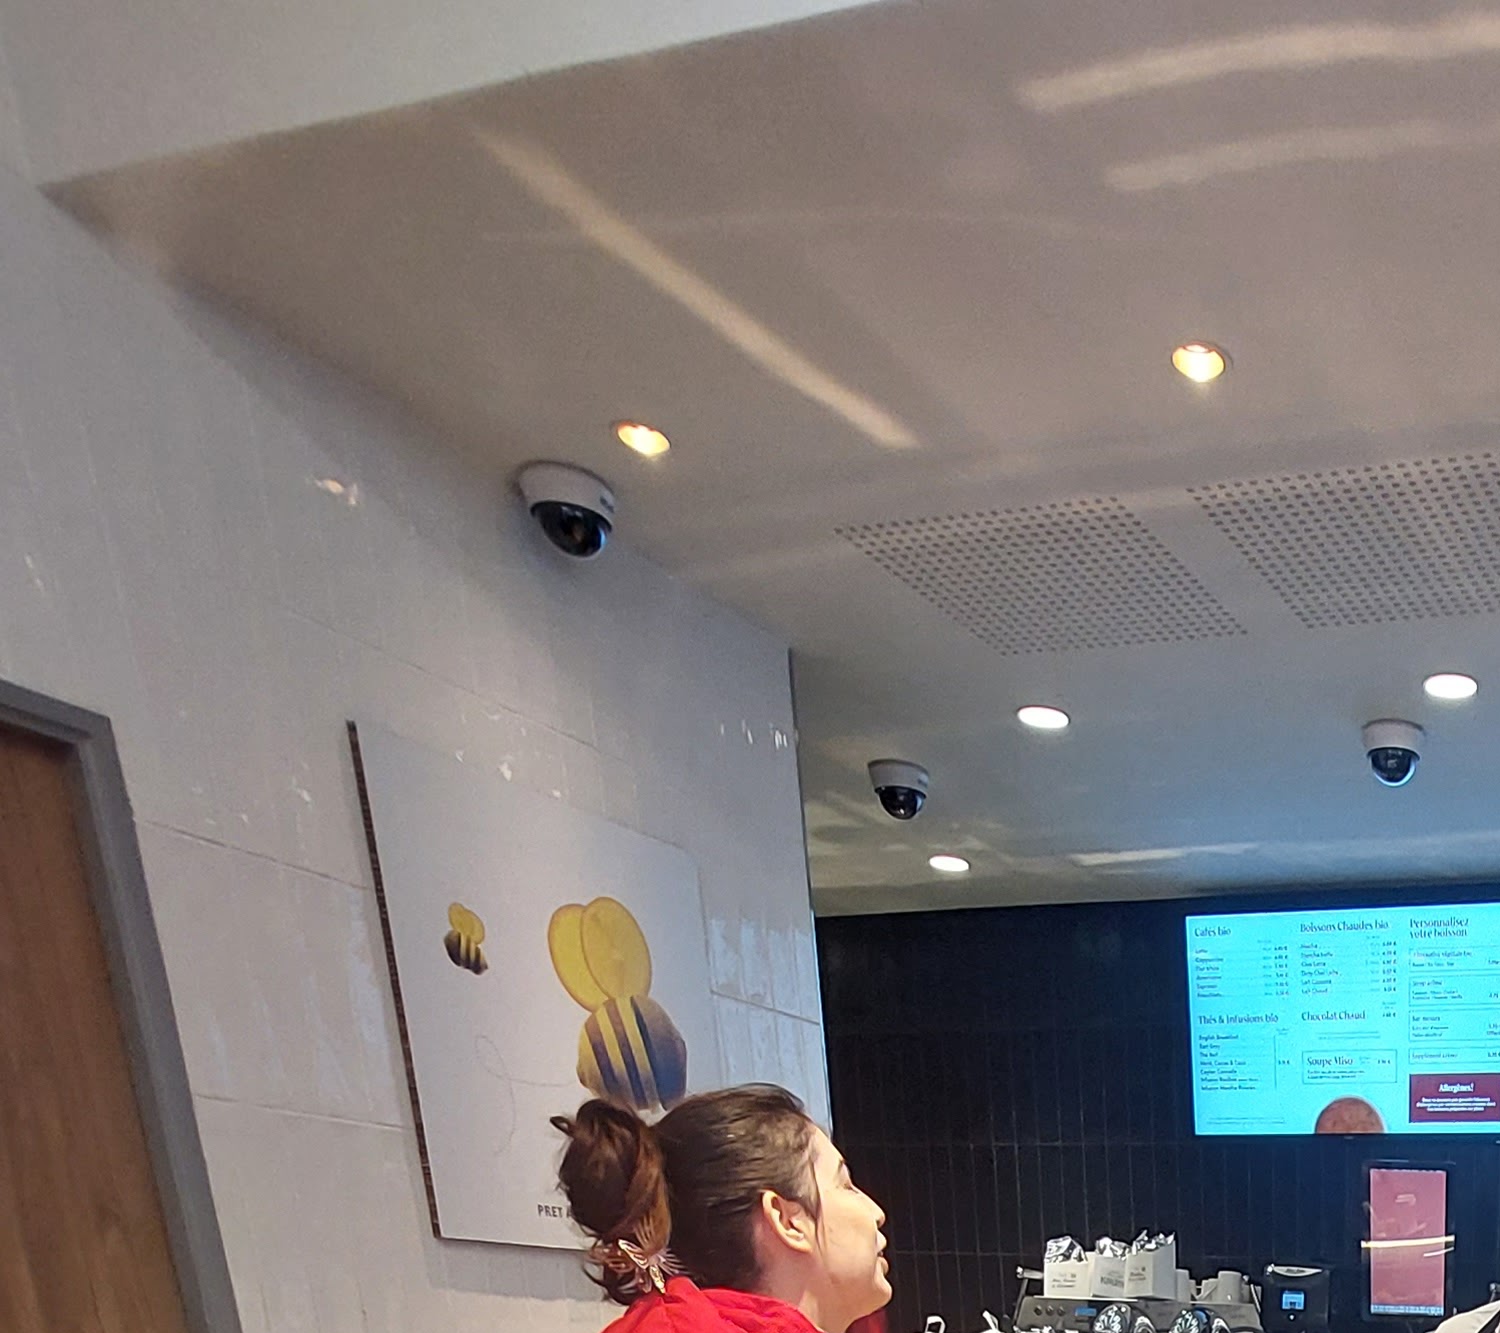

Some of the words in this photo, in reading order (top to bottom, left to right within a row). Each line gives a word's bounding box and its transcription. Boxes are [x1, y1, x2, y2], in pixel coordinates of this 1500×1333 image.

[1300, 922, 1336, 933] Boissons
[1337, 920, 1373, 931] Chaudes
[1374, 919, 1389, 929] bio
[1409, 916, 1469, 928] Personnalisez
[1217, 925, 1231, 936] bio
[1198, 1014, 1217, 1024] Thés
[1218, 1014, 1225, 1024] &
[1226, 1013, 1263, 1024] Infusions
[1265, 1012, 1279, 1023] bio
[1301, 1010, 1337, 1021] Chocolat
[1338, 1009, 1366, 1020] Chaud
[1307, 1055, 1332, 1067] Soupe
[537, 1203, 563, 1219] PRET
